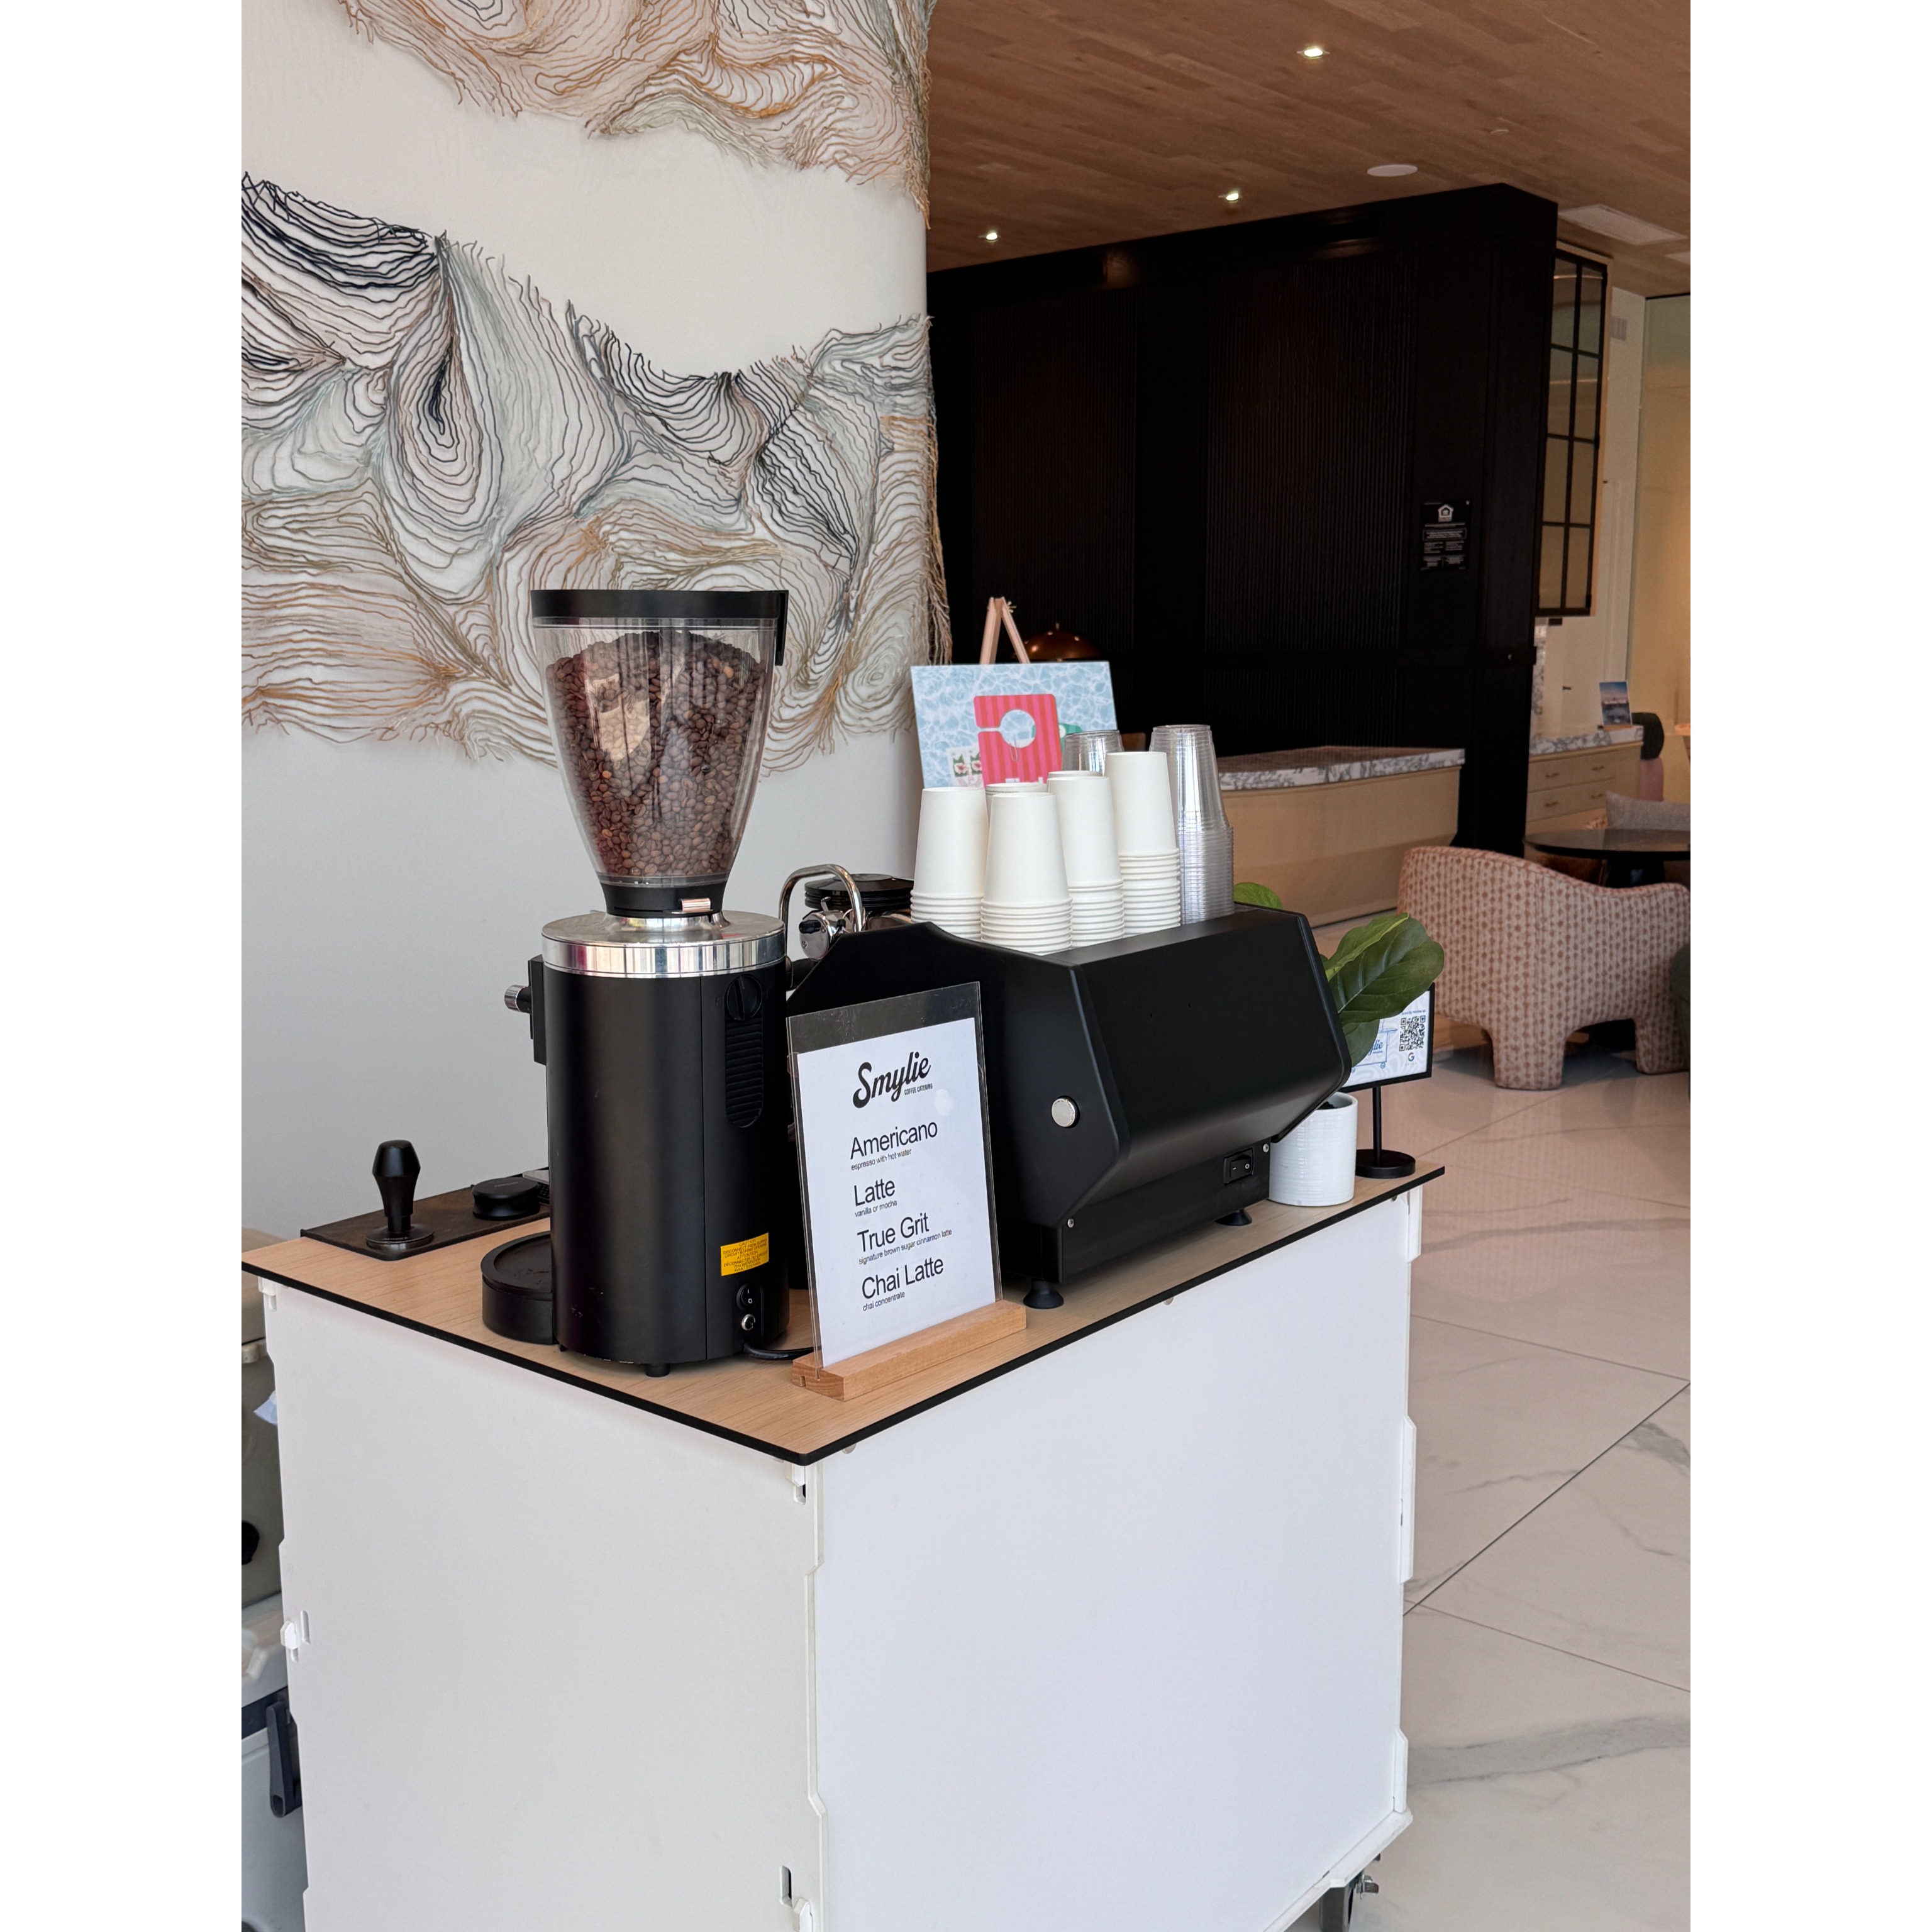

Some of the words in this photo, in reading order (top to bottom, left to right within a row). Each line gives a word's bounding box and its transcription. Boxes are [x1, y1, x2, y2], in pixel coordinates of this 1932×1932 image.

[852, 1052, 931, 1109] Smylie
[904, 1087, 916, 1096] COFFEE
[917, 1083, 933, 1093] CATERING
[850, 1122, 938, 1160] Americano
[851, 1159, 876, 1171] espresso
[876, 1155, 887, 1163] with
[887, 1152, 897, 1160] hot
[897, 1148, 912, 1158] water
[854, 1178, 896, 1206] Latte
[855, 1207, 872, 1218] vanilla
[879, 1200, 897, 1211] mocha
[857, 1227, 896, 1252] True
[900, 1212, 930, 1238] Grit
[858, 1251, 884, 1265] signature
[884, 1245, 901, 1257] brown
[901, 1241, 916, 1250] sugar
[916, 1233, 941, 1246] cinnamon
[941, 1228, 952, 1238] latte
[862, 1267, 900, 1299] Chai
[904, 1257, 944, 1285] Latte
[863, 1300, 874, 1311] chai
[875, 1291, 906, 1307] concentrate
